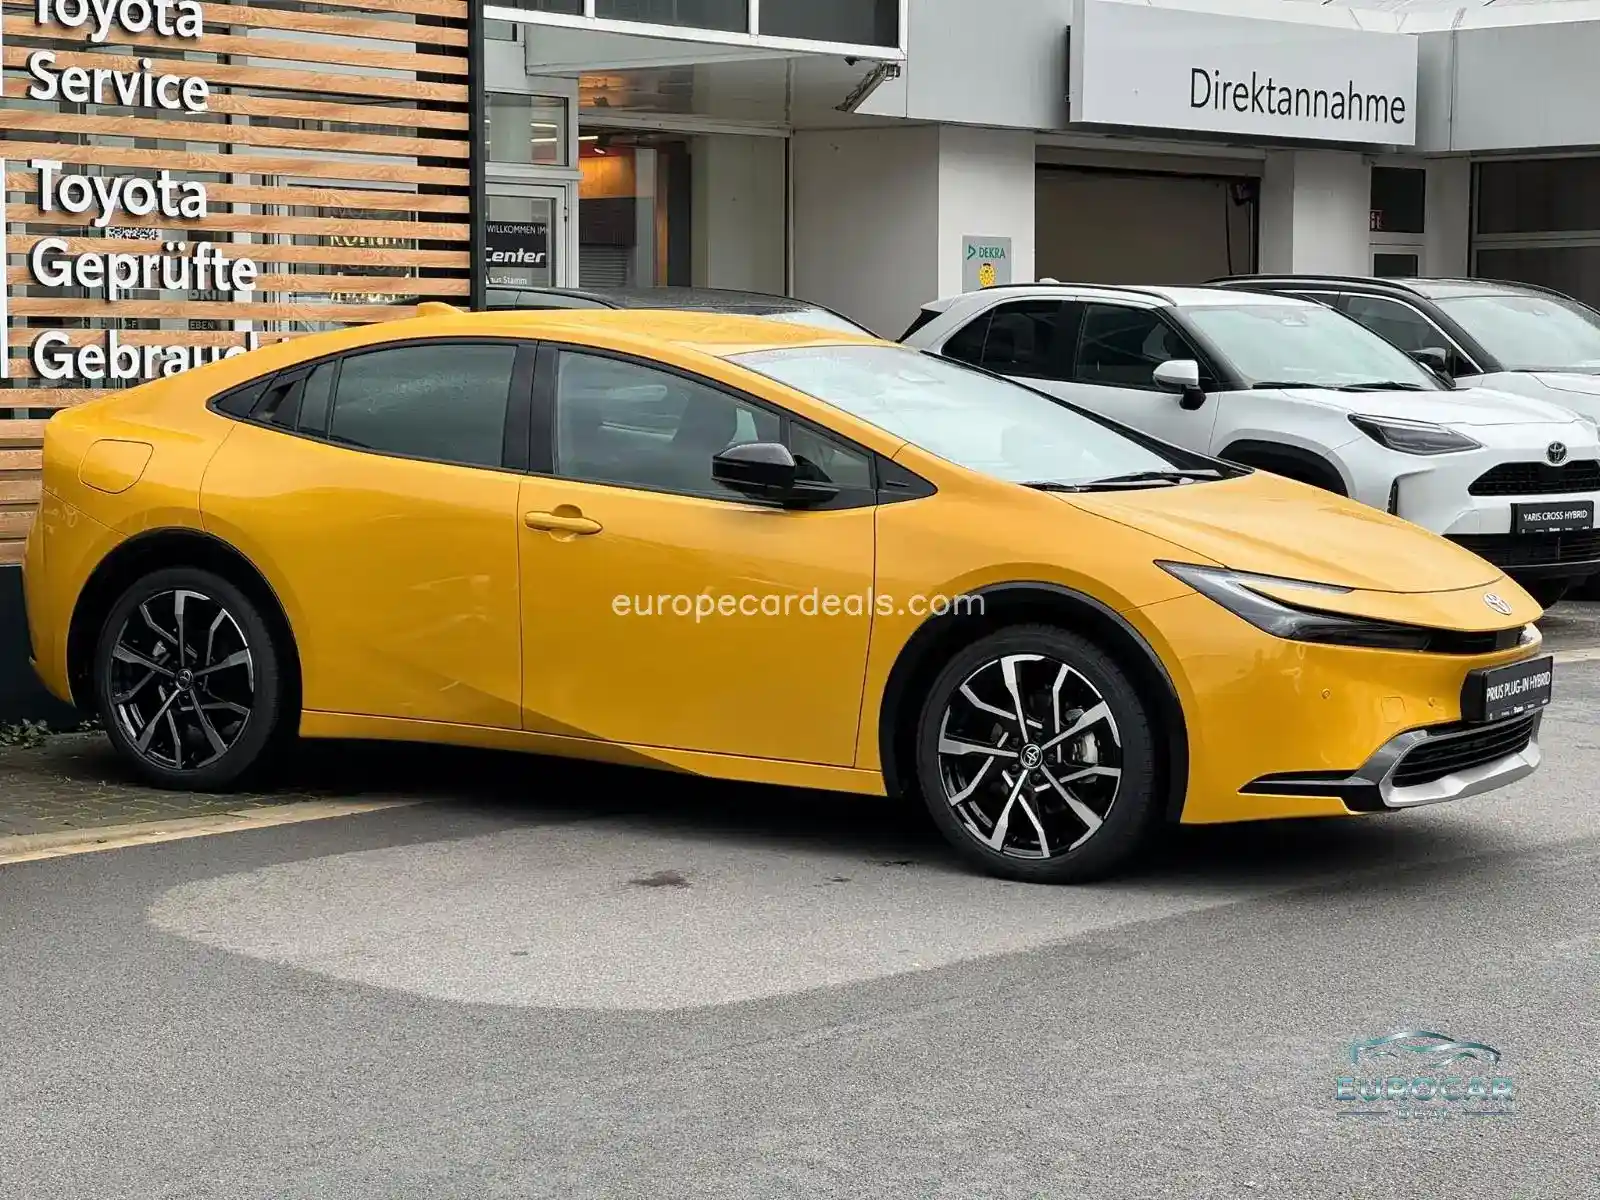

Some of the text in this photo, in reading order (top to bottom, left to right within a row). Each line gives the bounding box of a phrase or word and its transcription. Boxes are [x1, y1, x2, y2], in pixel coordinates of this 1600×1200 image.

[29, 51, 209, 112] Service
[1190, 67, 1406, 124] Direktannahme
[30, 159, 207, 227] Toyota
[487, 224, 546, 236] WILLKOMMEN IM
[979, 246, 1006, 259] DEKRA
[31, 238, 258, 301] Geprüfte
[33, 330, 259, 380] Gebrau
[1523, 509, 1588, 522] YARIS CROSS HYBRID
[1486, 671, 1551, 702] PRIUS PLUG-IN HYBRID
